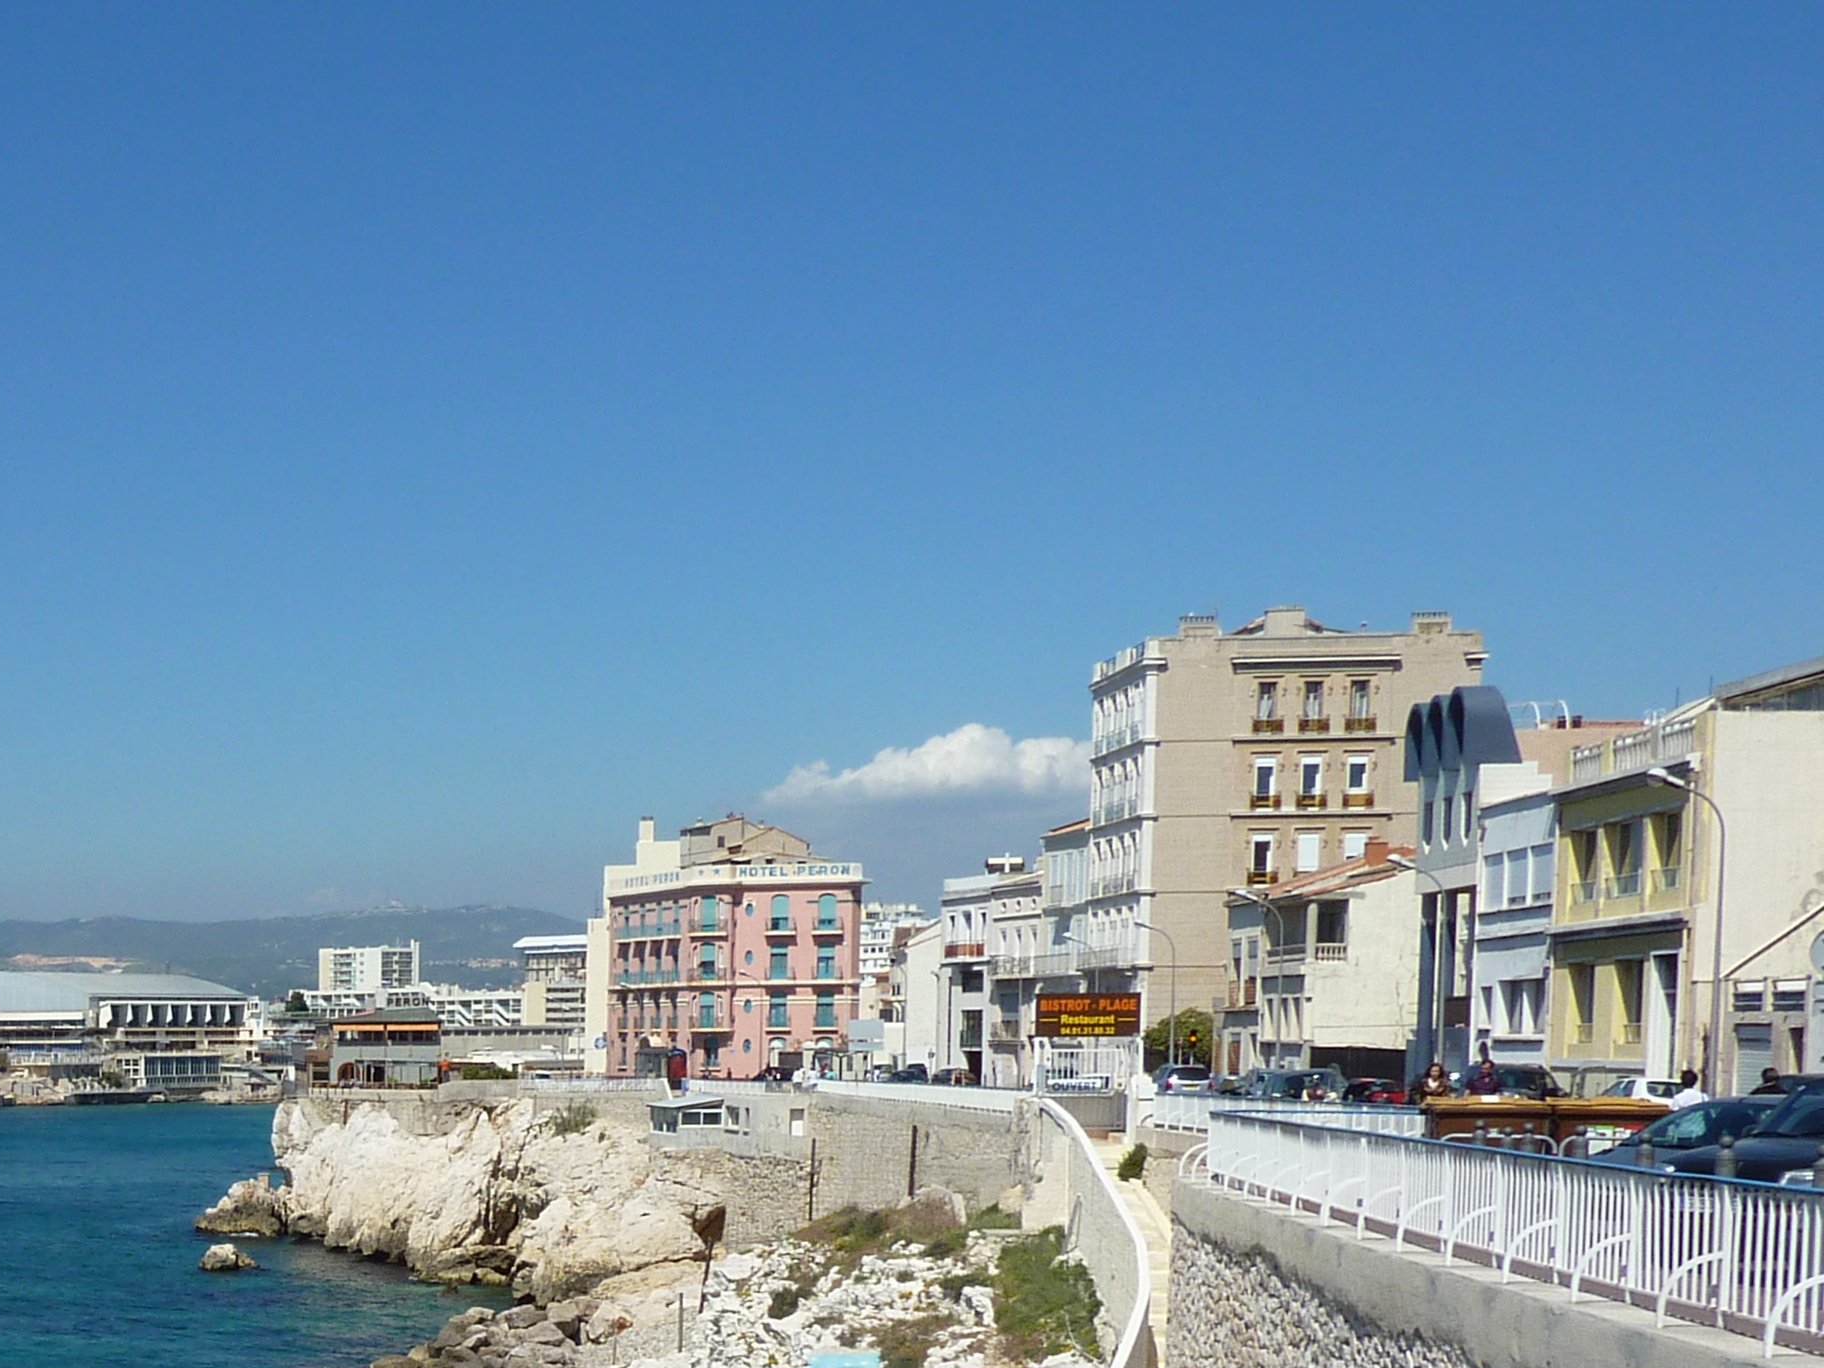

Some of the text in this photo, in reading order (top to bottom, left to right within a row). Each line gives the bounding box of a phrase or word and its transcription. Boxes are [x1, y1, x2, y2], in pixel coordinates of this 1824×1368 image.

[739, 865, 851, 877] HOTEL PERON
[386, 997, 431, 1007] PERON
[1040, 999, 1091, 1011] BISTROT
[1098, 998, 1137, 1011] PLAGE
[1060, 1014, 1115, 1025] Restaurant
[1052, 1081, 1097, 1091] OUVERT
